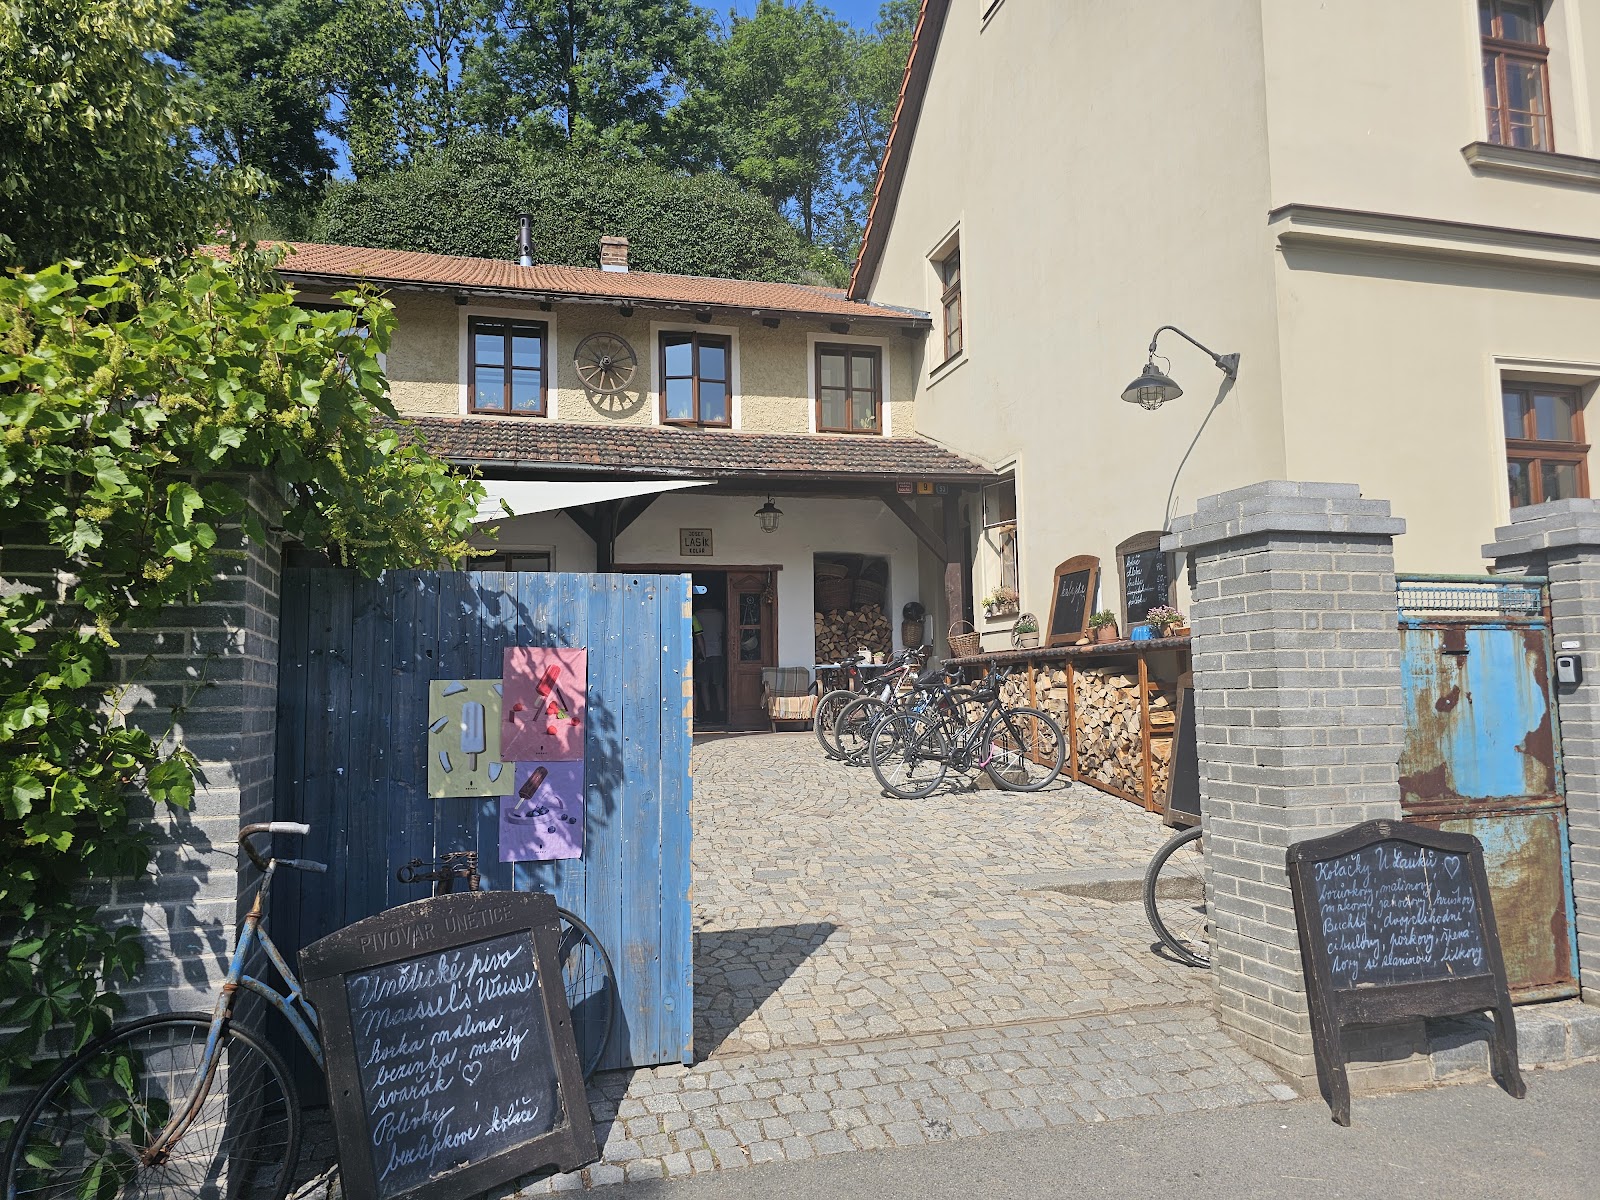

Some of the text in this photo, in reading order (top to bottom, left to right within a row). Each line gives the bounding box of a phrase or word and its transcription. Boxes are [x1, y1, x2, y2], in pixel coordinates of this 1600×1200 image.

[923, 482, 928, 491] 9
[359, 923, 436, 954] PIVOVAR
[465, 945, 523, 988] pivo
[364, 1009, 504, 1069] horká malina
[468, 1028, 529, 1062] mošty
[371, 1067, 455, 1116] svařák
